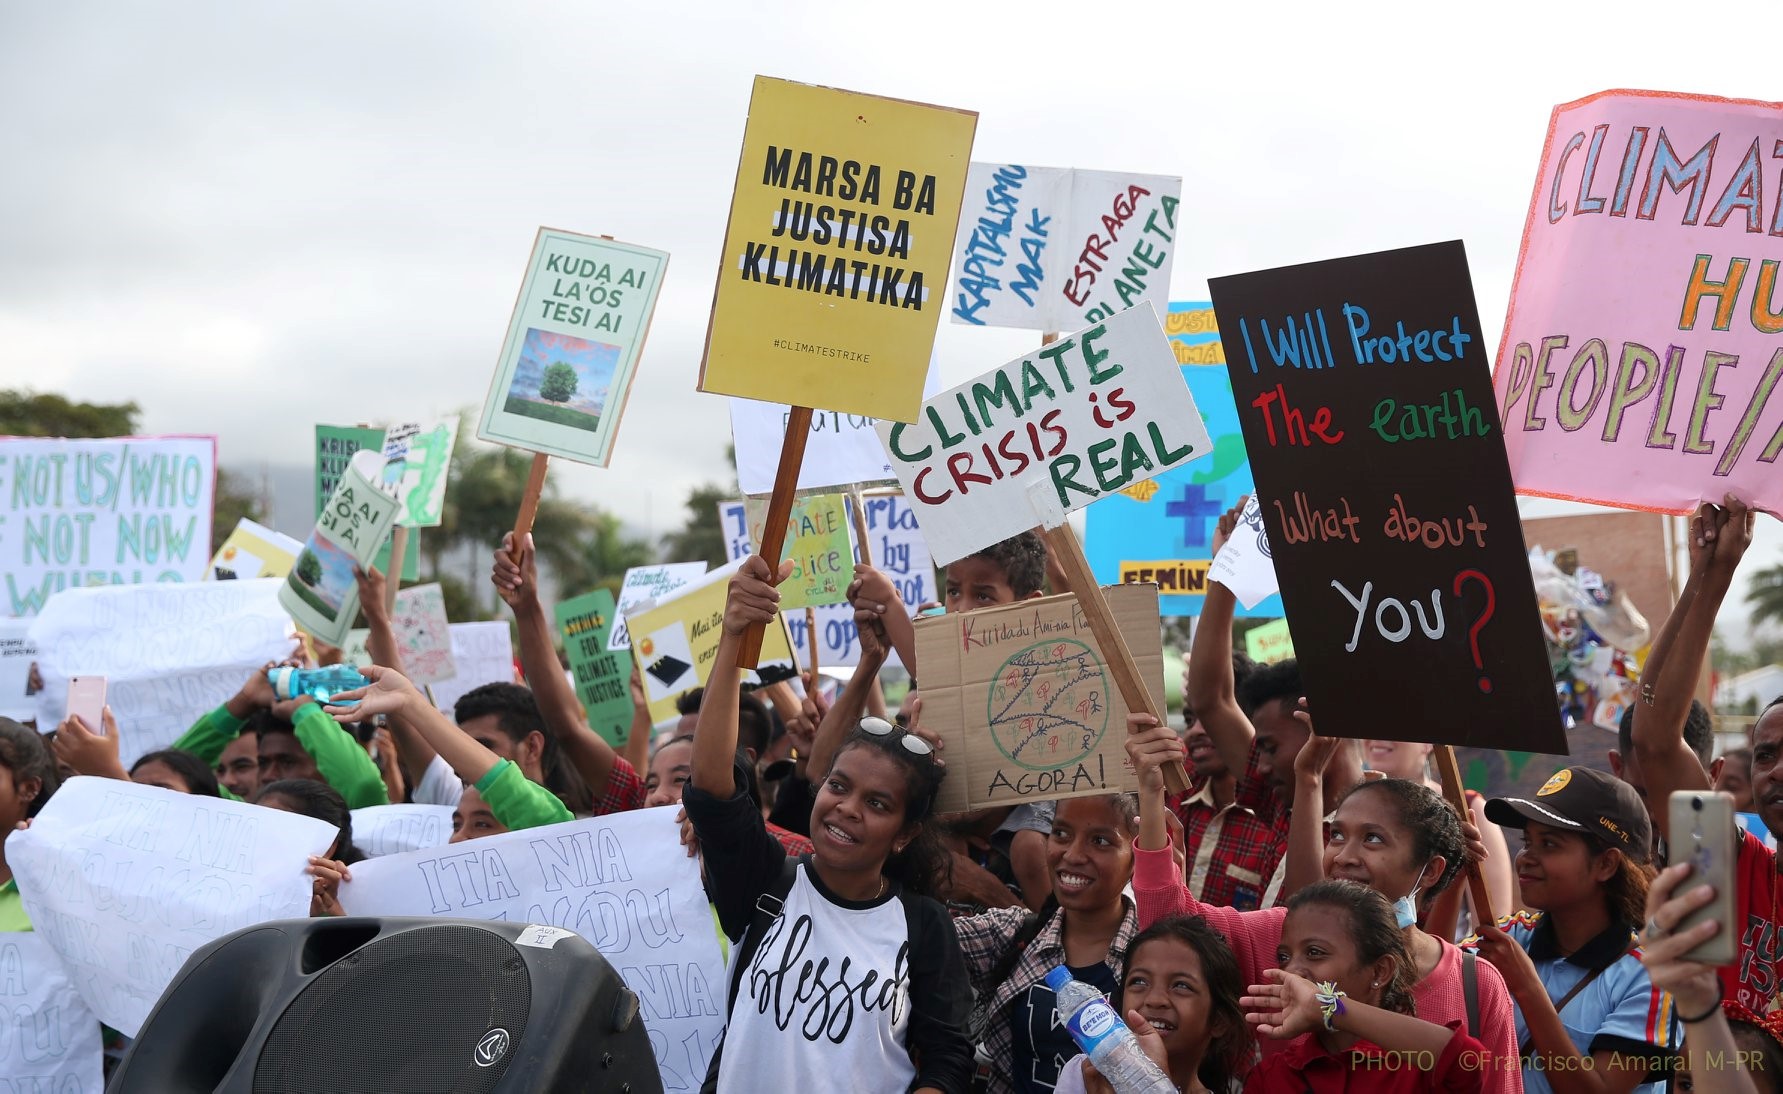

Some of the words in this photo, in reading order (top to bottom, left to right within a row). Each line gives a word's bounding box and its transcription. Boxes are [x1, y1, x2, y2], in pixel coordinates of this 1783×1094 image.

[762, 145, 881, 205] MARSA
[892, 169, 936, 216] BA
[772, 198, 910, 260] JUSTISA
[1009, 207, 1051, 308] MAK
[1063, 184, 1151, 307] ESTRAGA
[546, 253, 612, 283] KUDA
[617, 268, 646, 290] AI
[741, 241, 925, 311] KLIMATIKA
[541, 299, 591, 327] TESI
[595, 314, 623, 334] AI
[1239, 317, 1258, 374] I
[1342, 302, 1471, 366] Protect
[773, 339, 871, 364] #CLIMATESTRIKE
[889, 324, 1124, 463] CLIMATE
[1252, 384, 1344, 447] The
[1368, 388, 1492, 443] earth
[913, 409, 1068, 505] CRISIS
[1087, 387, 1136, 428] is
[1048, 421, 1194, 509] REAL
[11, 453, 69, 511] NOT
[23, 513, 96, 566] NOT
[116, 512, 198, 566] NOW
[358, 502, 380, 525] AI
[1274, 491, 1360, 545] What
[1383, 494, 1488, 549] about
[882, 536, 911, 575] by
[577, 655, 619, 684] CLIMATE
[580, 636, 600, 657] FOR
[585, 679, 625, 706] JUSTICE
[988, 754, 1107, 797] AGORA!
[81, 789, 171, 853] ITA
[175, 806, 260, 876] NIA
[1599, 816, 1630, 844] UNE-TL
[418, 847, 521, 914] ITA
[529, 827, 633, 892] NIA
[621, 962, 719, 1022] NIA
[751, 914, 909, 1045] blessed
